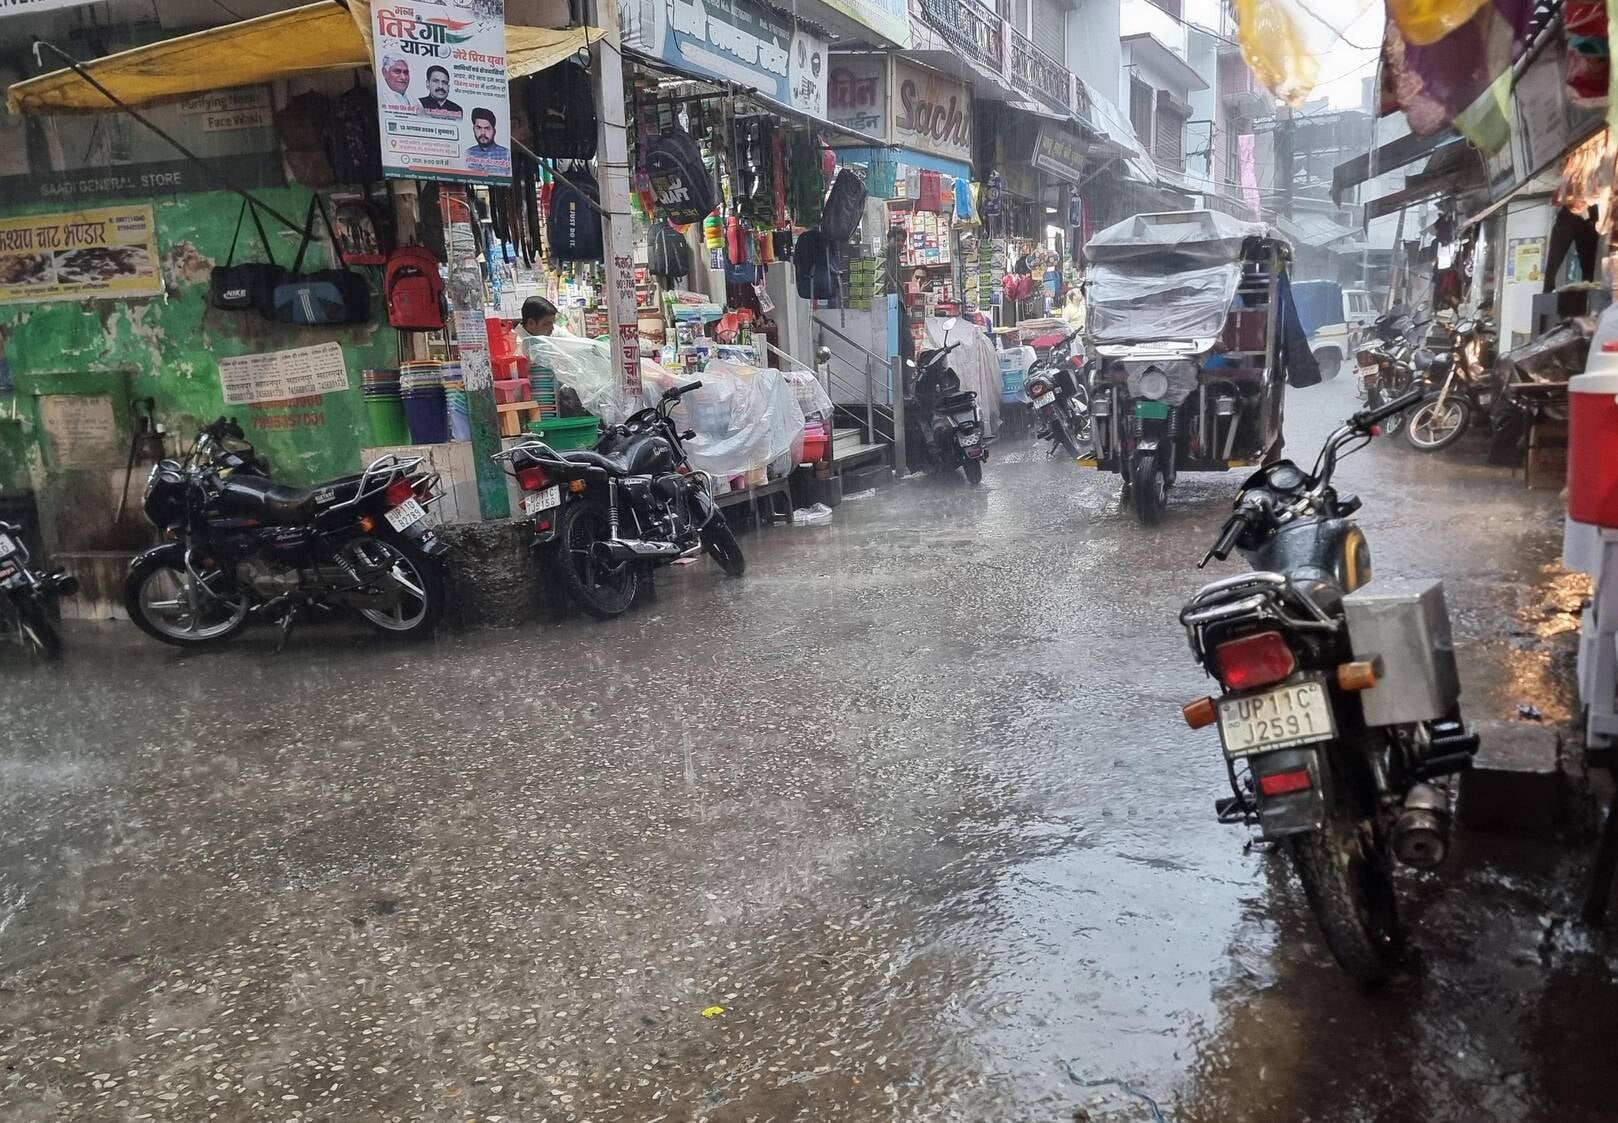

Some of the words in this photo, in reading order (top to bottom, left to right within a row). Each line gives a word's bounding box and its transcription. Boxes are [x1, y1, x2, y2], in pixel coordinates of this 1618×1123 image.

[377, 9, 448, 44] तिरंगा
[400, 39, 440, 57] यात्रा
[453, 48, 467, 60] मेरे
[468, 50, 486, 63] प्रिय
[487, 55, 504, 68] युवा
[208, 117, 233, 128] Face
[80, 177, 136, 192] GENERAL
[141, 172, 181, 187] STORE
[36, 226, 60, 248] चाट
[63, 221, 106, 247] भण्डार
[226, 288, 247, 298] NIKE
[1238, 688, 1310, 720] UP11C
[1244, 712, 1315, 744] J2591
